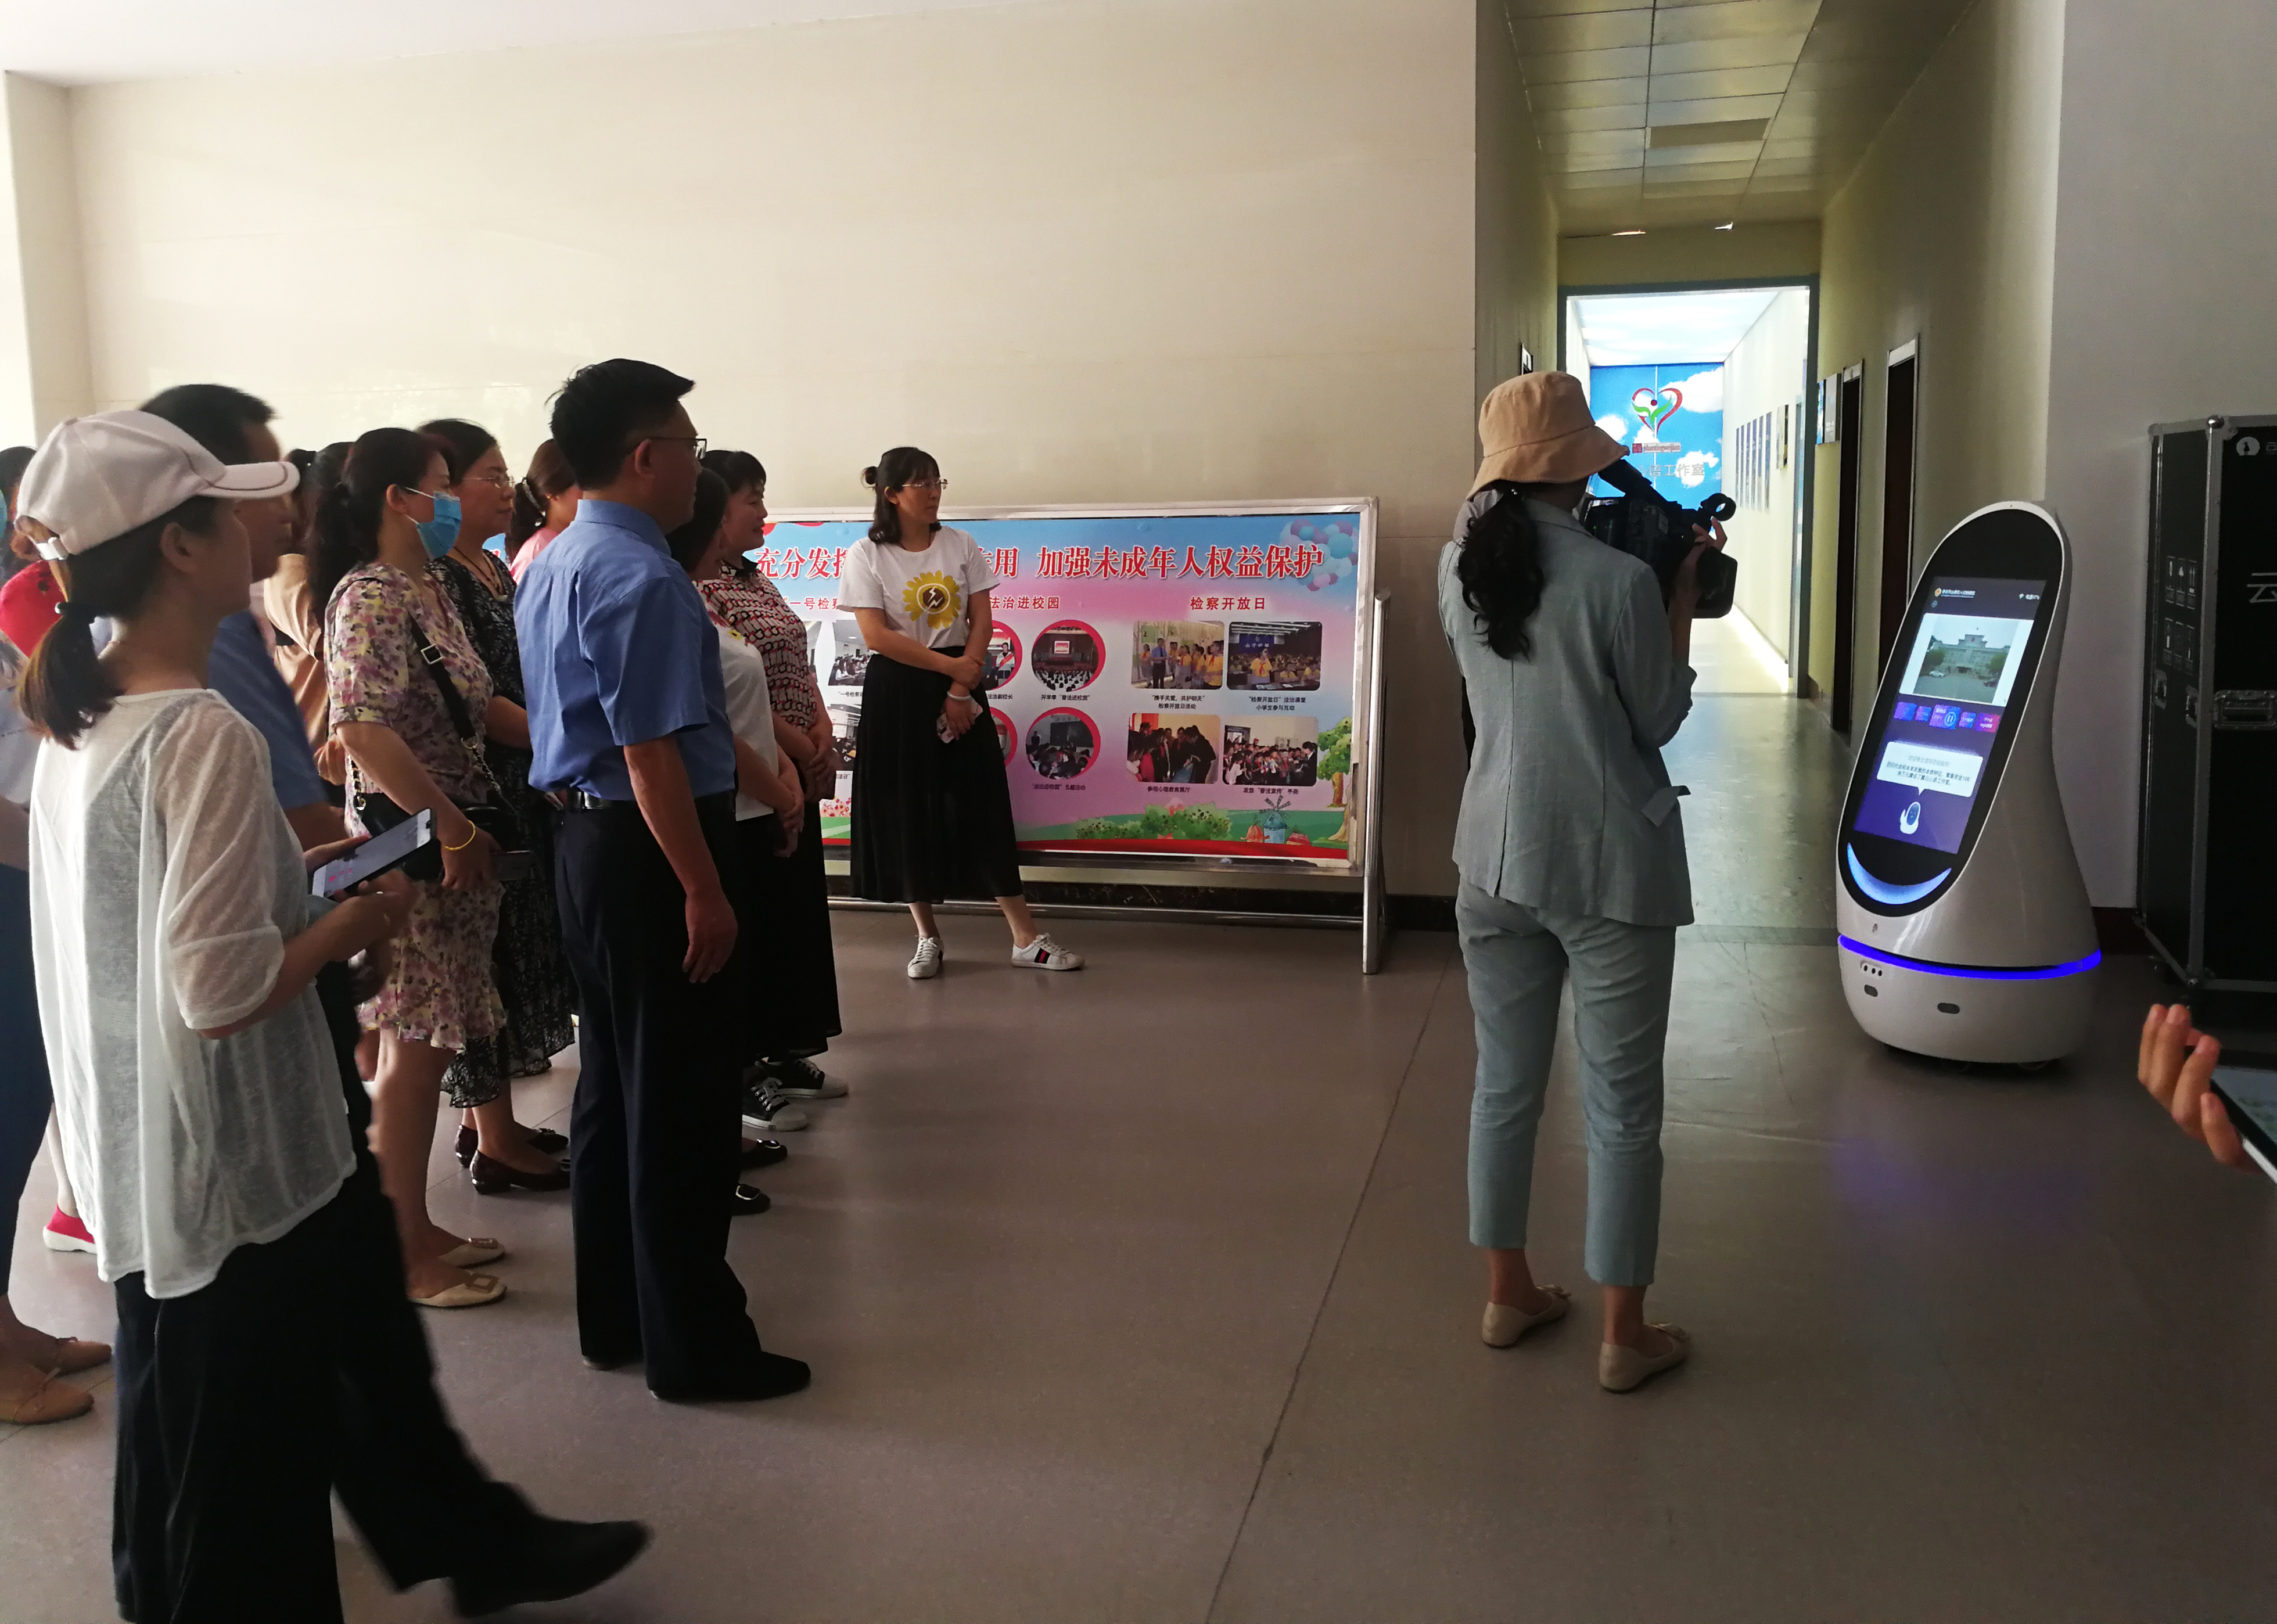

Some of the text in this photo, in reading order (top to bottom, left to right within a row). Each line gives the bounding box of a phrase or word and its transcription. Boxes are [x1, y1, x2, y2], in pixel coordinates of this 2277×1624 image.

[1036, 545, 1323, 579] 加强未成年人权益保护
[1190, 597, 1265, 610] 检察开放日
